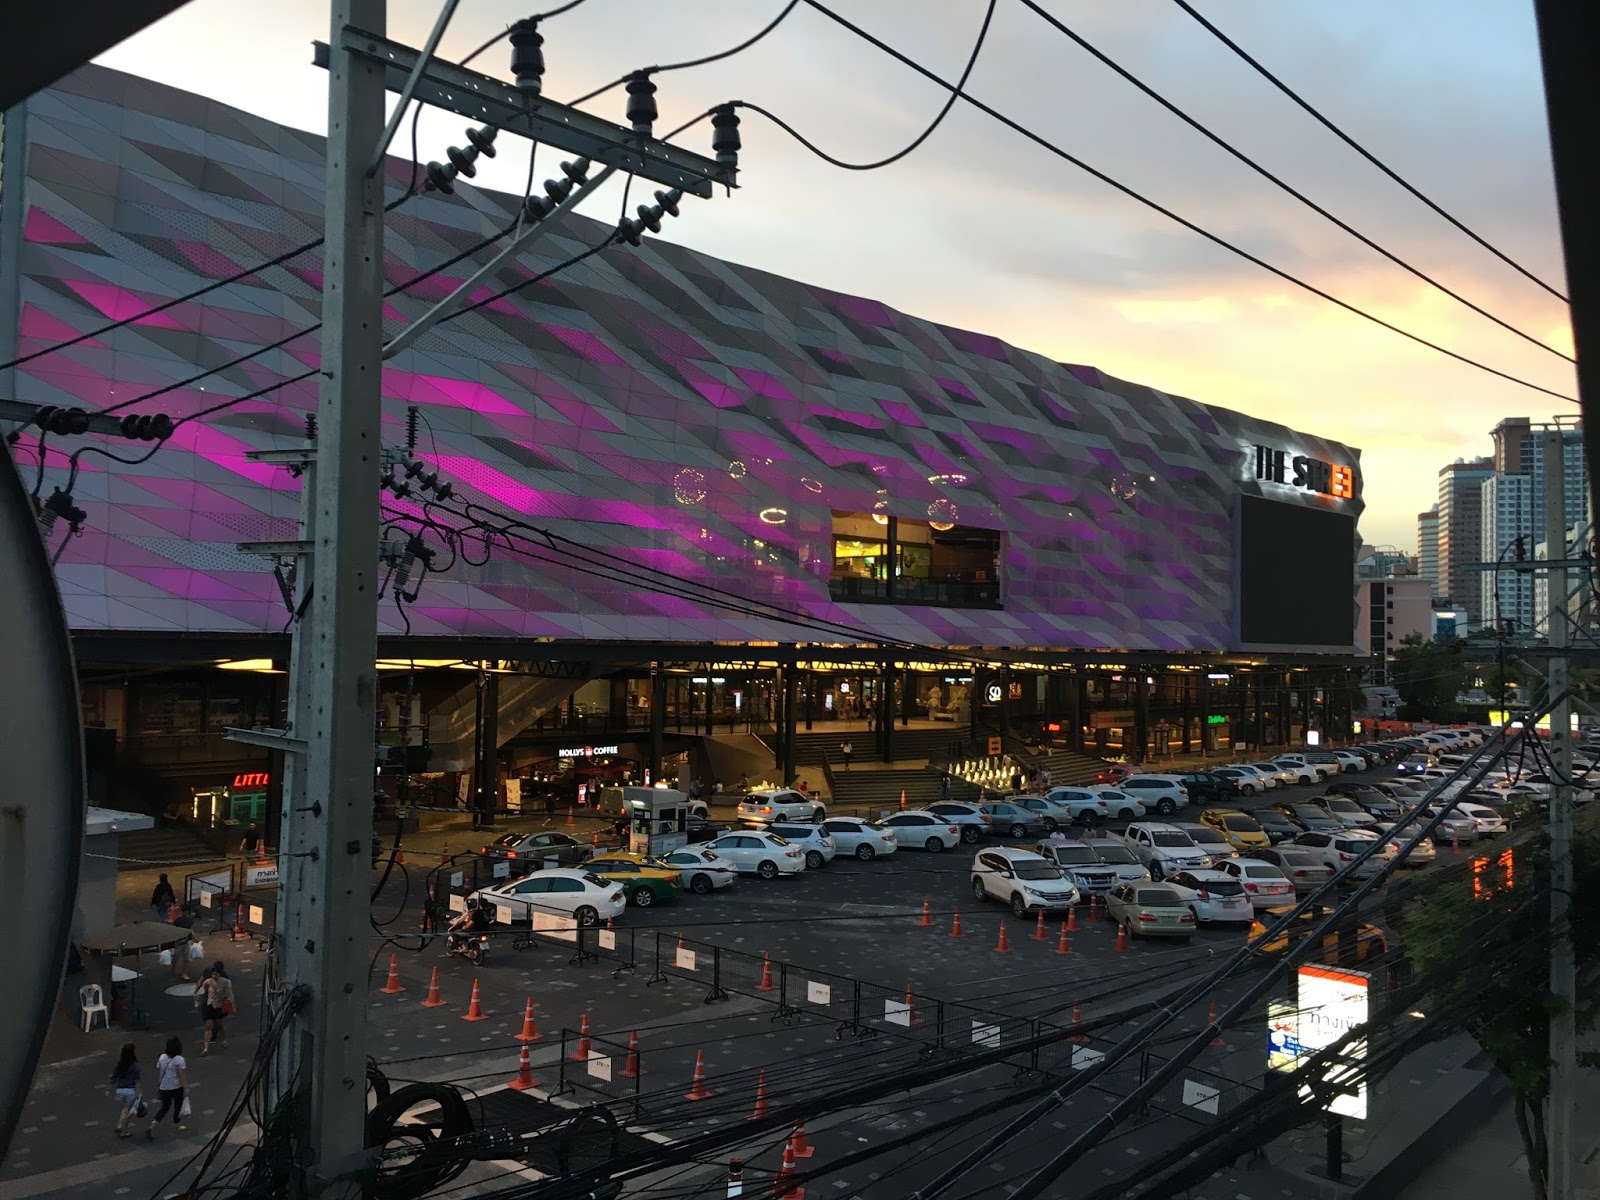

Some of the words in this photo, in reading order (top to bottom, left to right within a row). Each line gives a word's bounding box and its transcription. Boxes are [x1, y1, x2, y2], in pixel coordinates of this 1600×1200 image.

[1252, 444, 1292, 485] THE
[558, 747, 585, 757] HOLLYS
[593, 745, 619, 755] COFFEE
